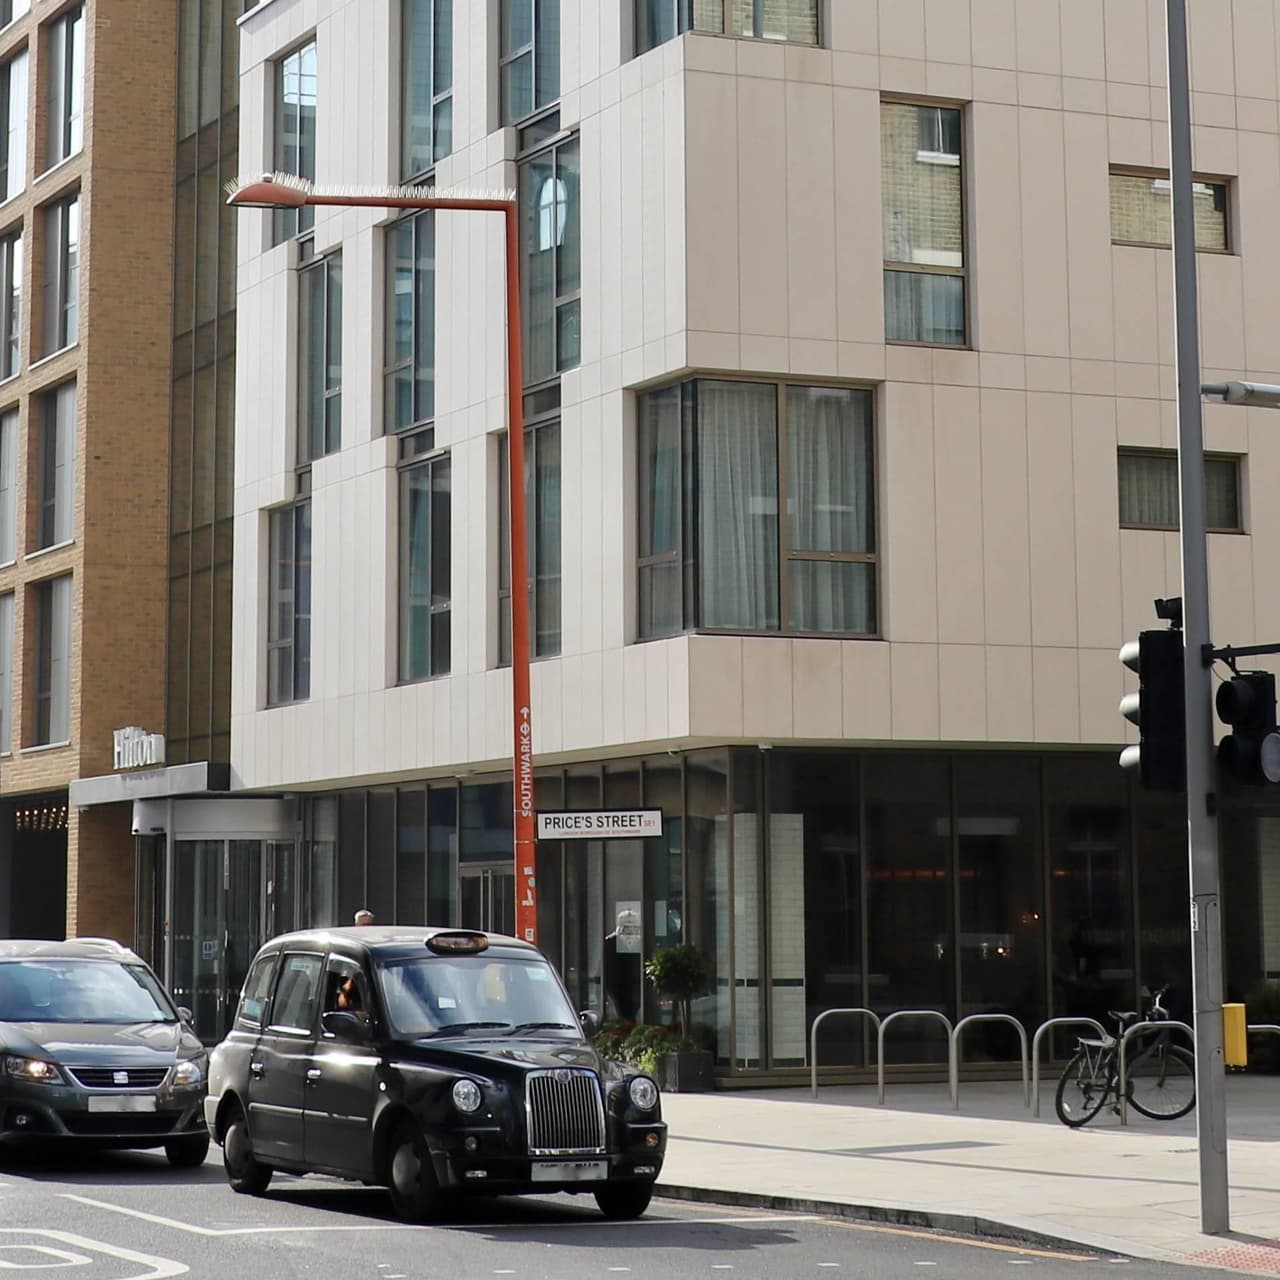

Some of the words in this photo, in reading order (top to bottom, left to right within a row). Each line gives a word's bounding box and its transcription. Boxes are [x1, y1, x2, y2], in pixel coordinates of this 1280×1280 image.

[113, 726, 166, 770] Hilton
[520, 736, 532, 817] SOUTHWARK
[544, 816, 593, 829] PRICE'S
[596, 815, 644, 828] STREET
